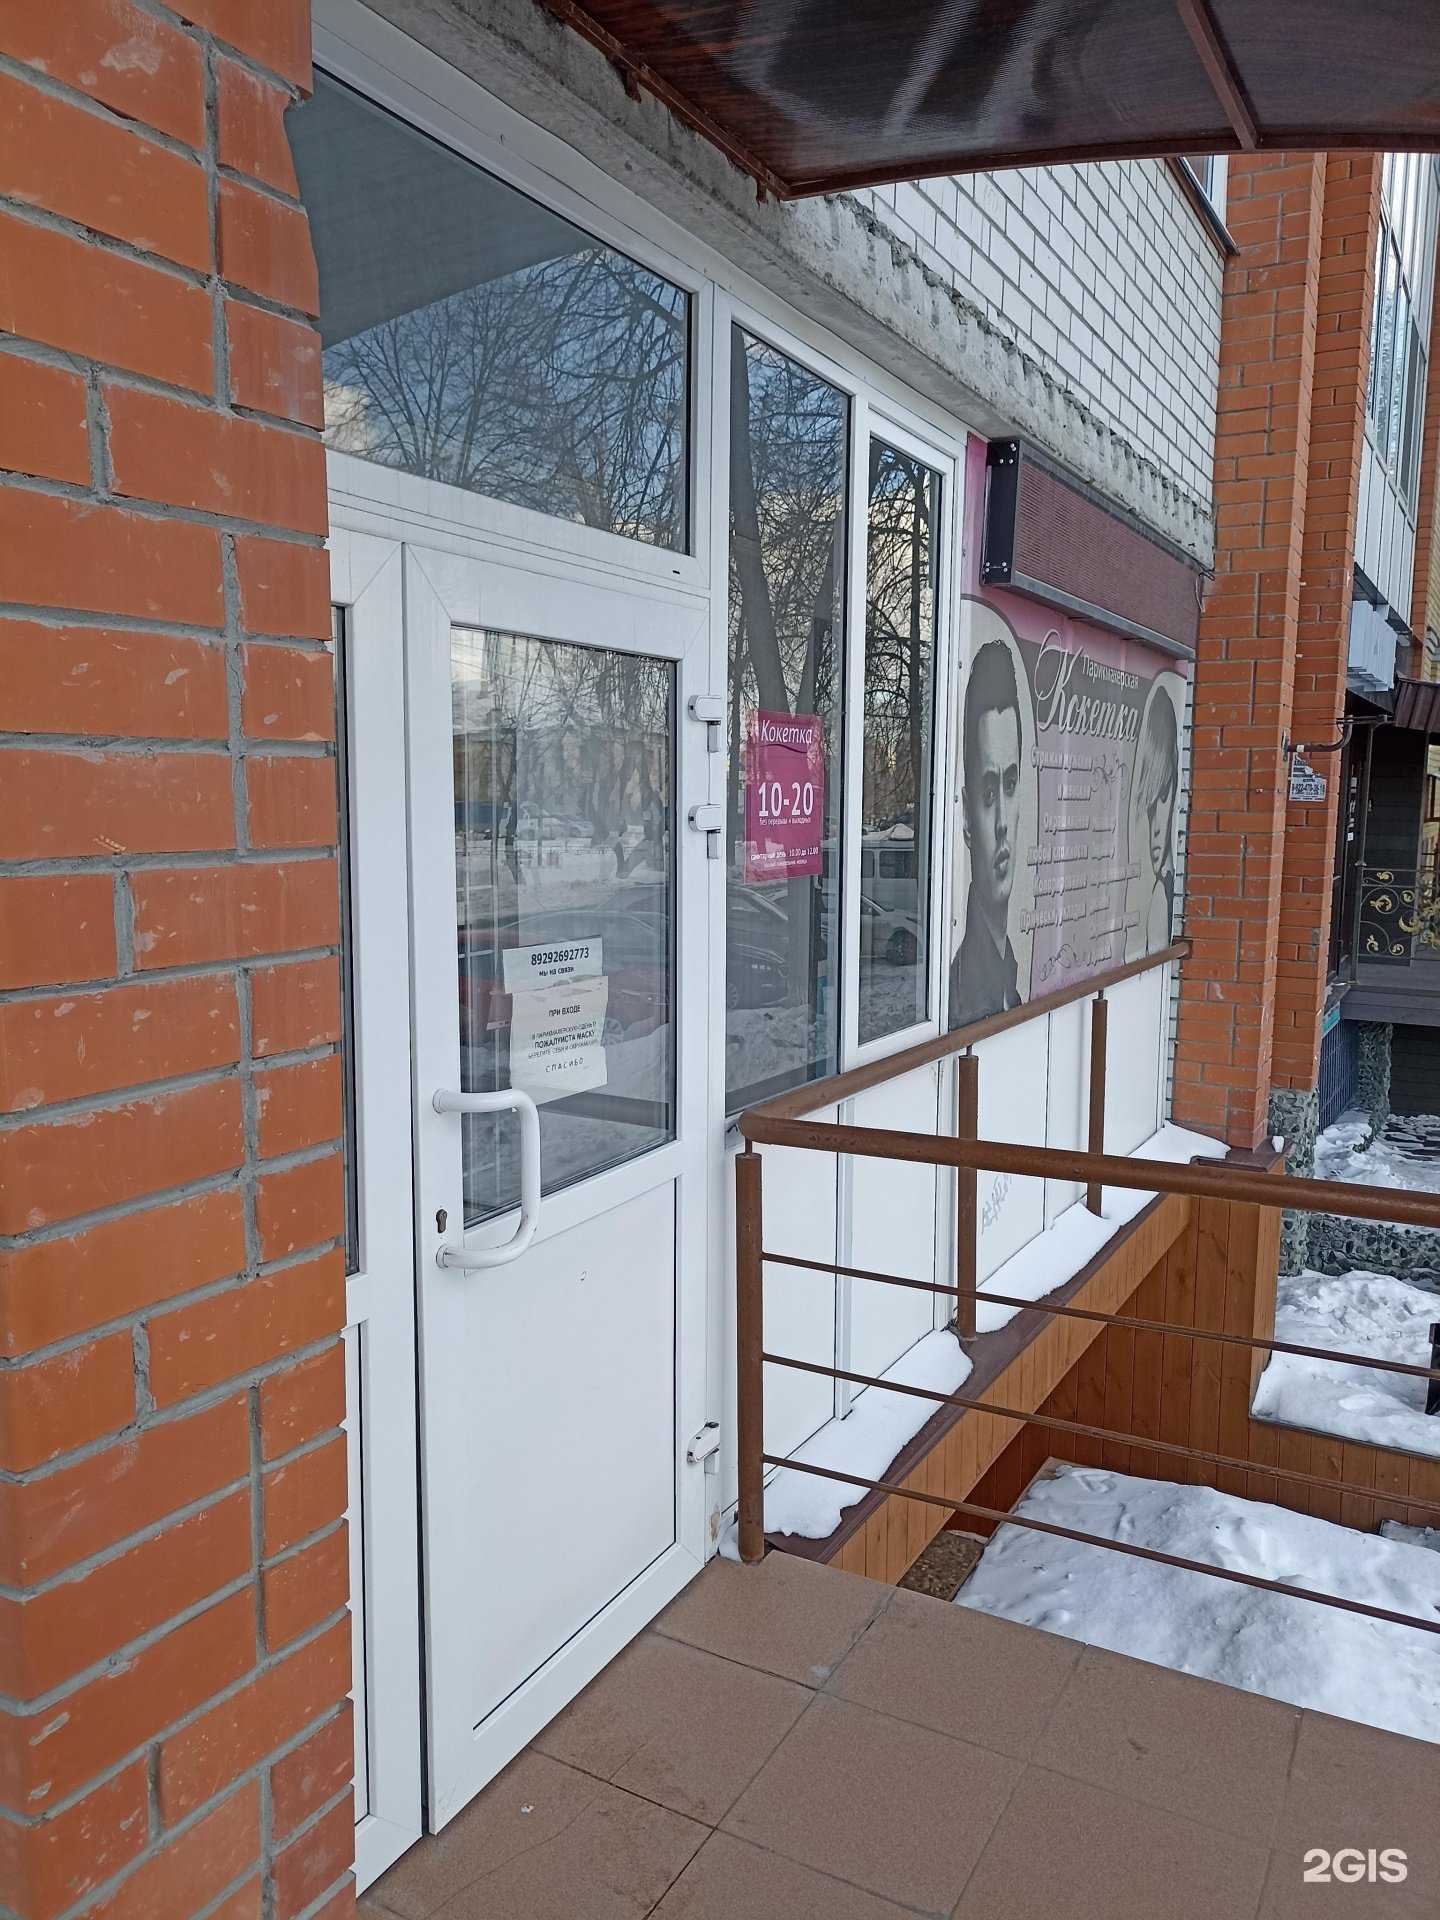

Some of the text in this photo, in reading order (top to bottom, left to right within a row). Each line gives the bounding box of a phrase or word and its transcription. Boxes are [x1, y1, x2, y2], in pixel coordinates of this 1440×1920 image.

[1034, 628, 1139, 742] Кокетка
[1081, 654, 1139, 691] Парикмахерская
[761, 719, 813, 744] Кокетка
[759, 782, 814, 817] 10-20
[531, 947, 590, 966] 89292692773
[561, 1004, 582, 1015] ВХОДЕ
